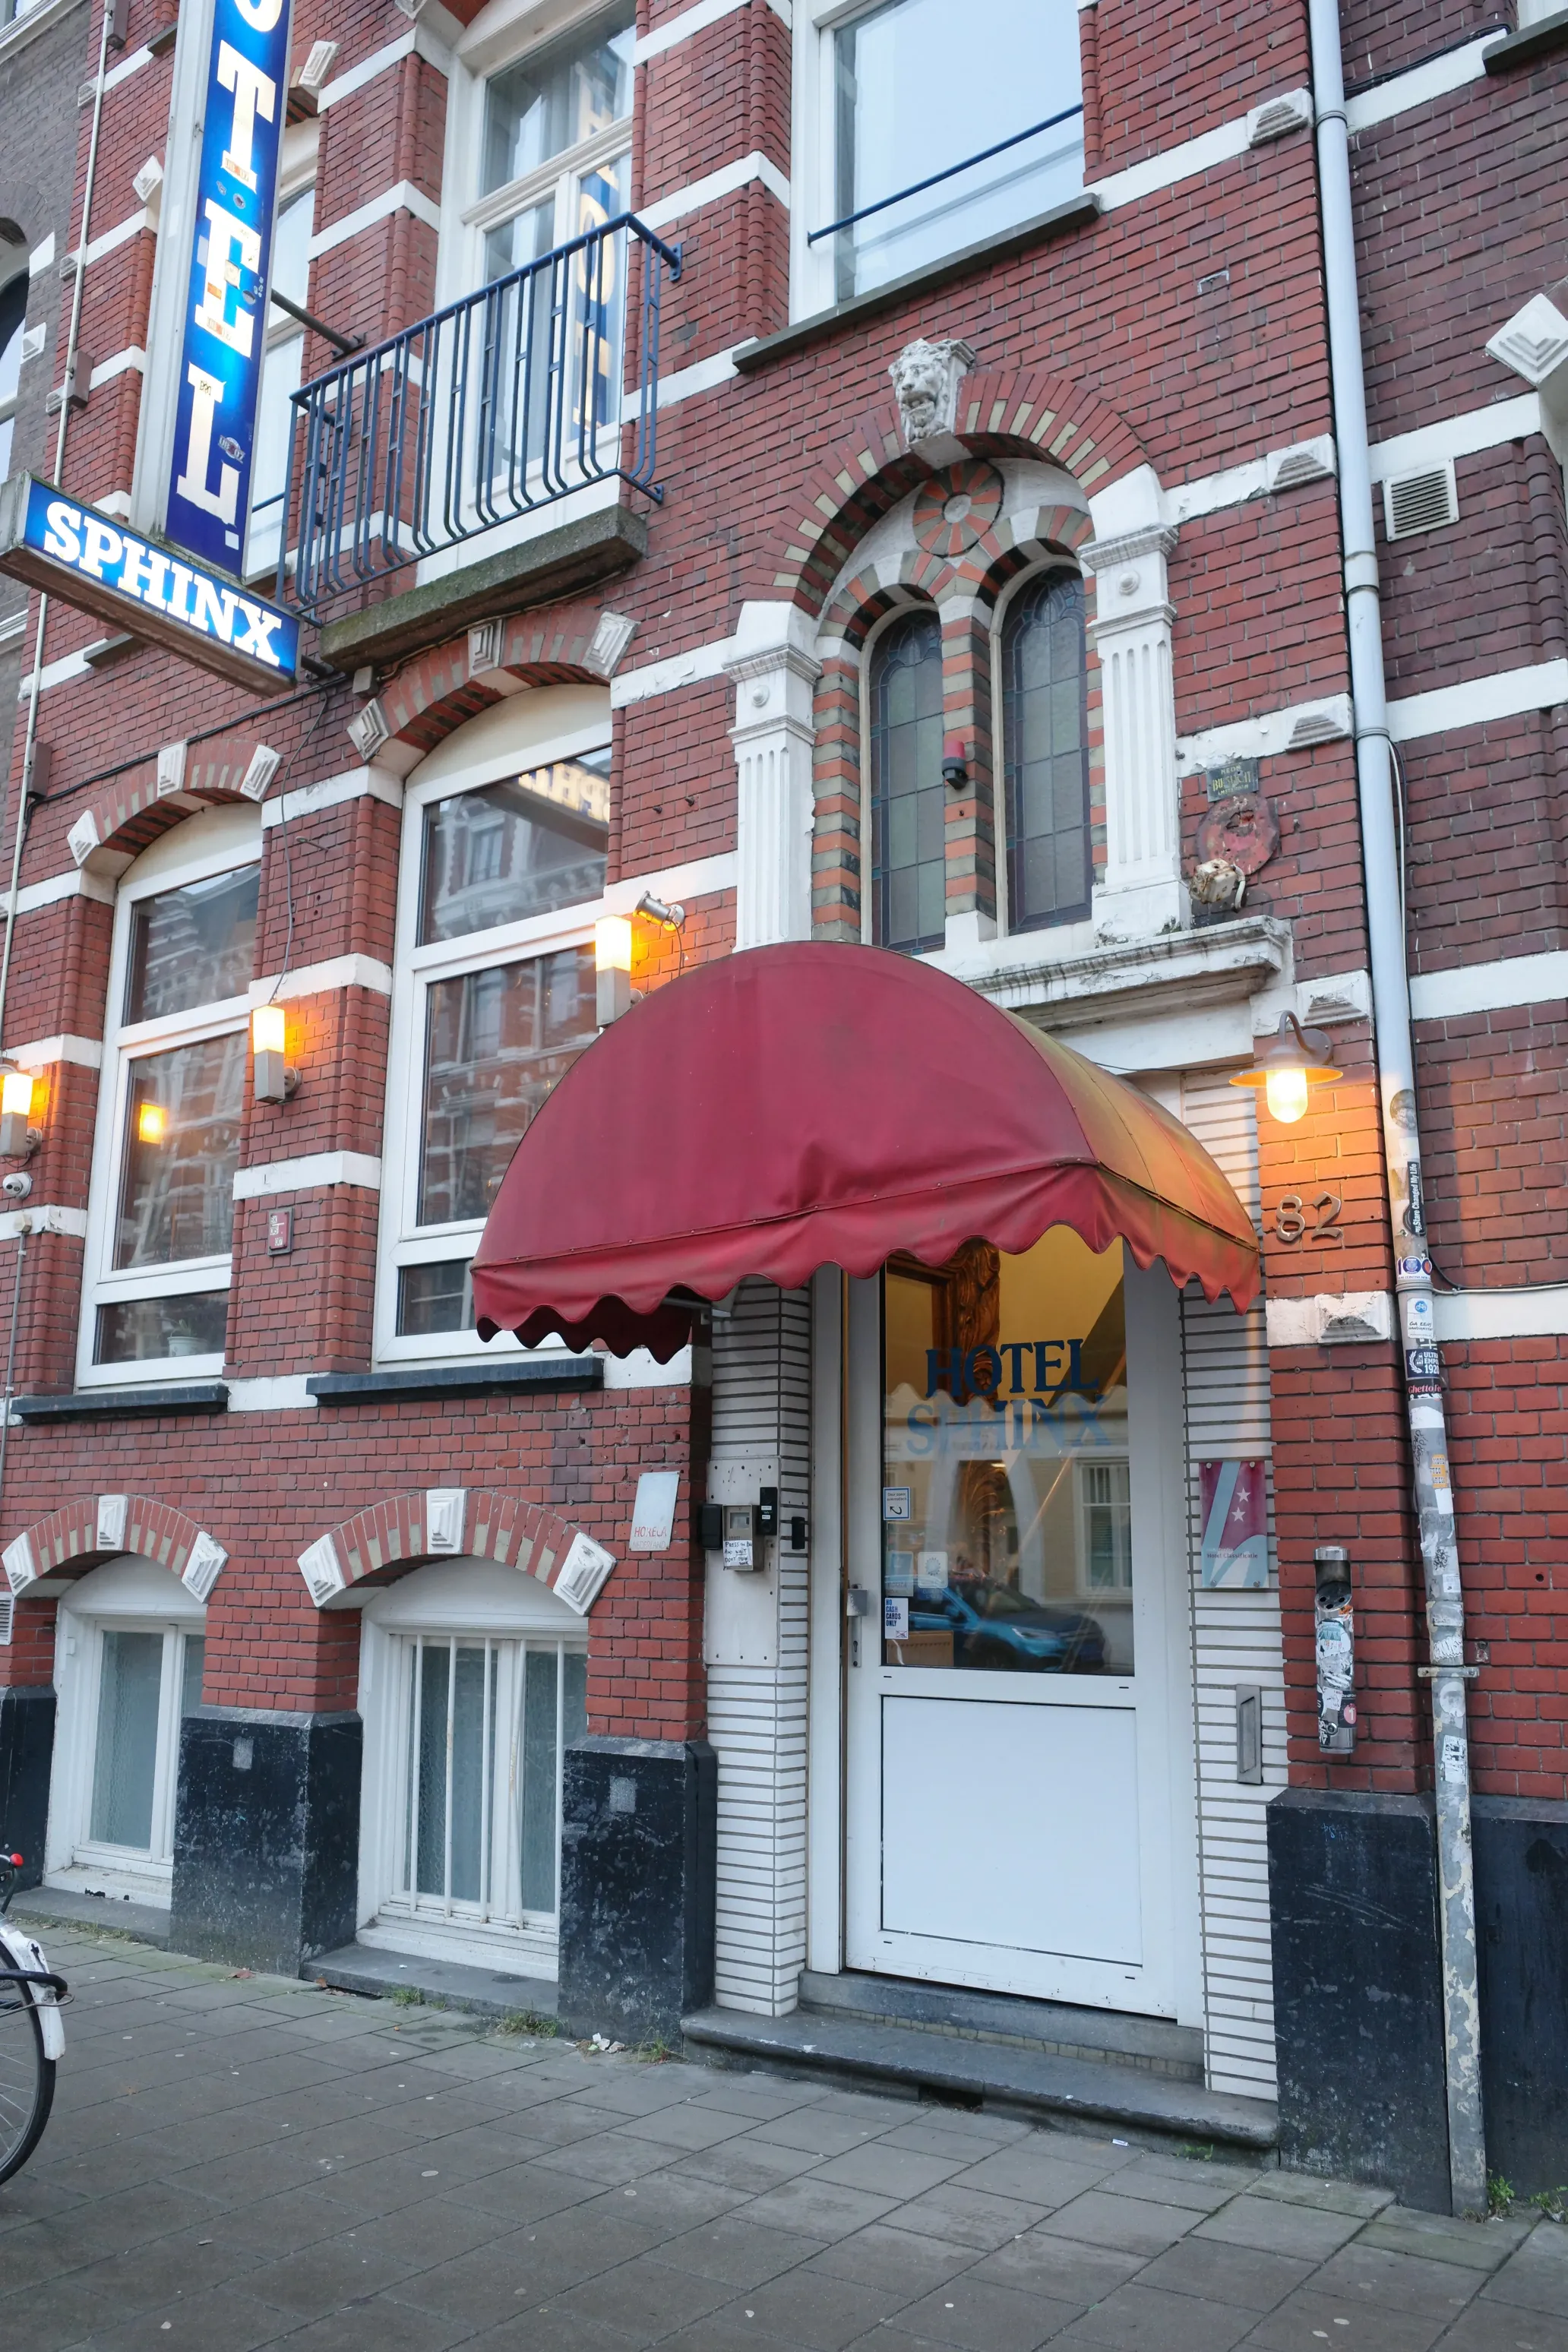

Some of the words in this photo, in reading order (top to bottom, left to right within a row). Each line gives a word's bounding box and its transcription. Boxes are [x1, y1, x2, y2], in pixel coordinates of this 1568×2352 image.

[44, 501, 282, 666] SPHINX
[1411, 1173, 1419, 1184] My
[1411, 1184, 1420, 1209] Changed
[1276, 1191, 1342, 1242] 82
[925, 1339, 1099, 1398] HOTEL
[1408, 1385, 1434, 1394] Ghetto
[906, 1395, 1113, 1455] SPHINX
[634, 1526, 667, 1538] HORECA
[633, 1541, 666, 1549] NEDERLAND
